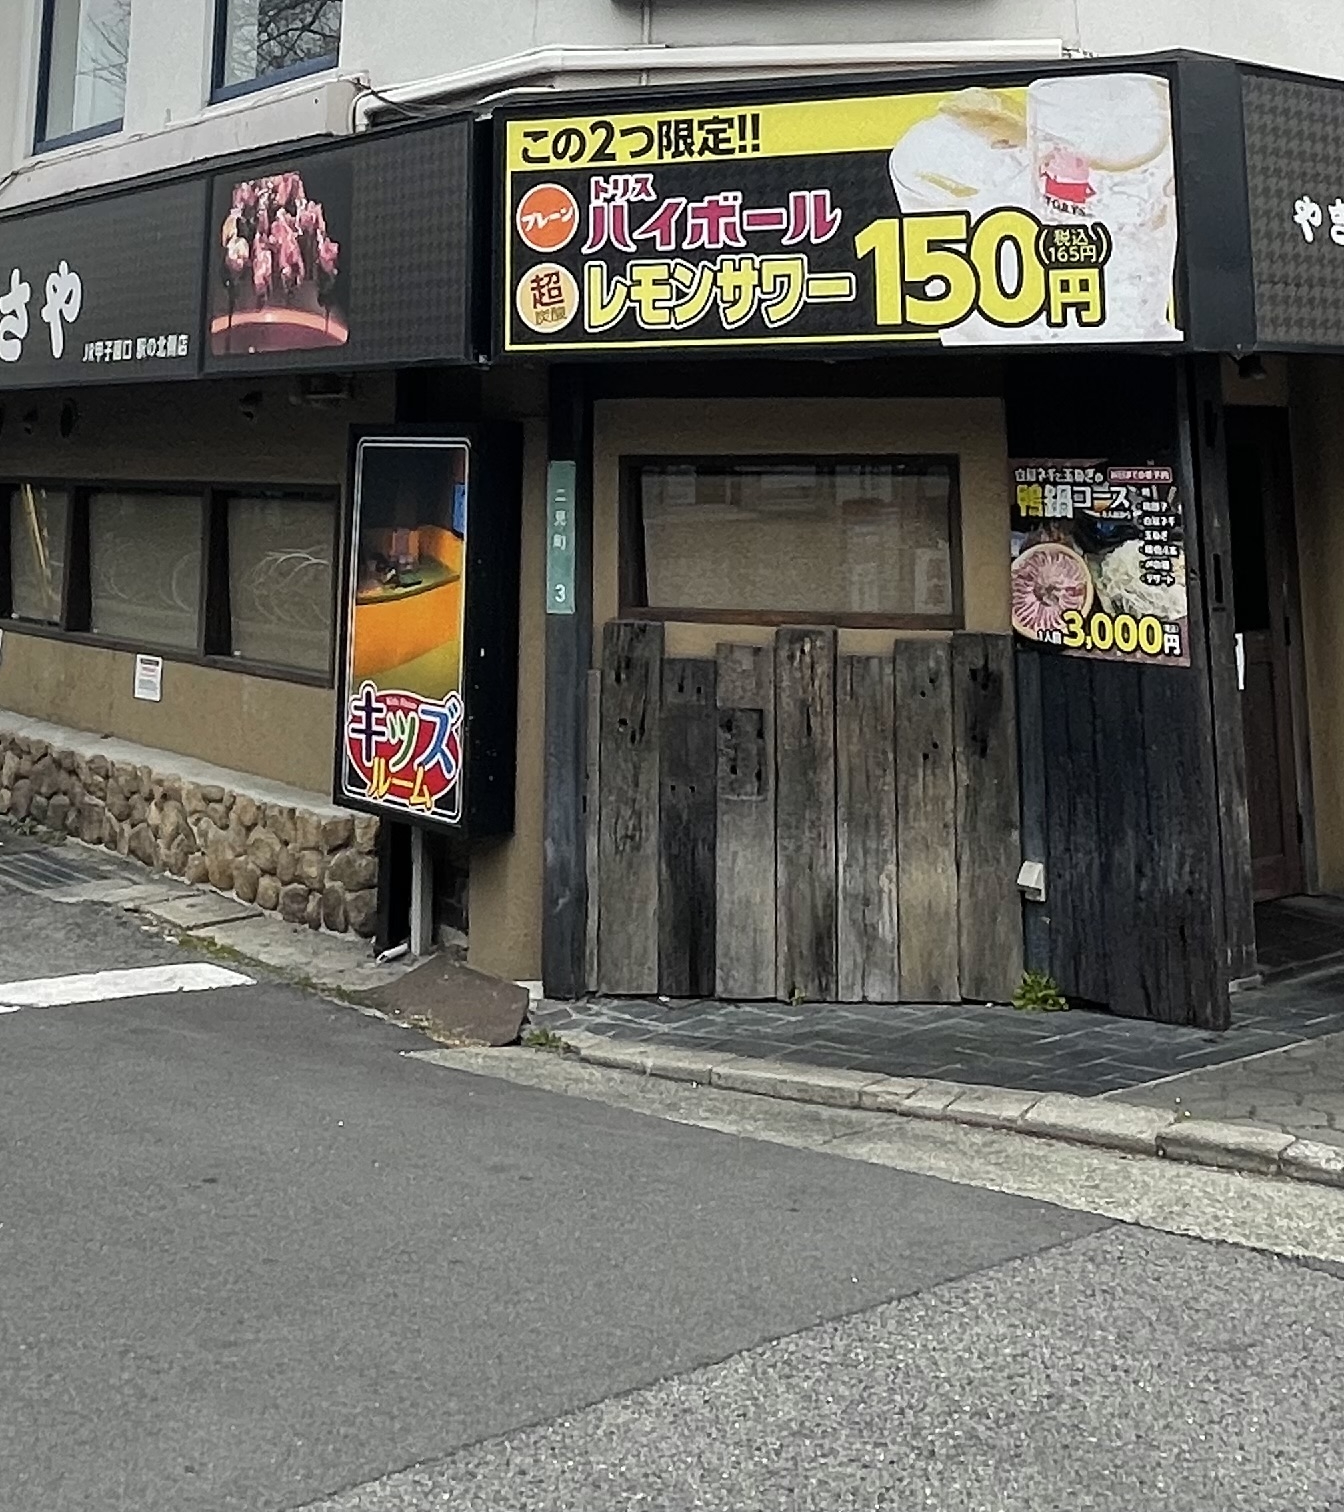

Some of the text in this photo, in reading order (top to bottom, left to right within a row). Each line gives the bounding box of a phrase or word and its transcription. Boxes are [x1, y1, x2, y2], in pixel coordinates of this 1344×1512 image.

[521, 113, 761, 164] この2つ限定!!
[589, 173, 655, 200] トリス
[581, 188, 842, 255] ハイボール
[1054, 229, 1089, 246] 税込
[1048, 244, 1097, 264] 165円
[530, 271, 565, 309] 超
[584, 255, 856, 333] レモンサワー
[554, 584, 566, 603] 3
[349, 686, 459, 778] キッズ
[367, 756, 433, 808] ルーム
